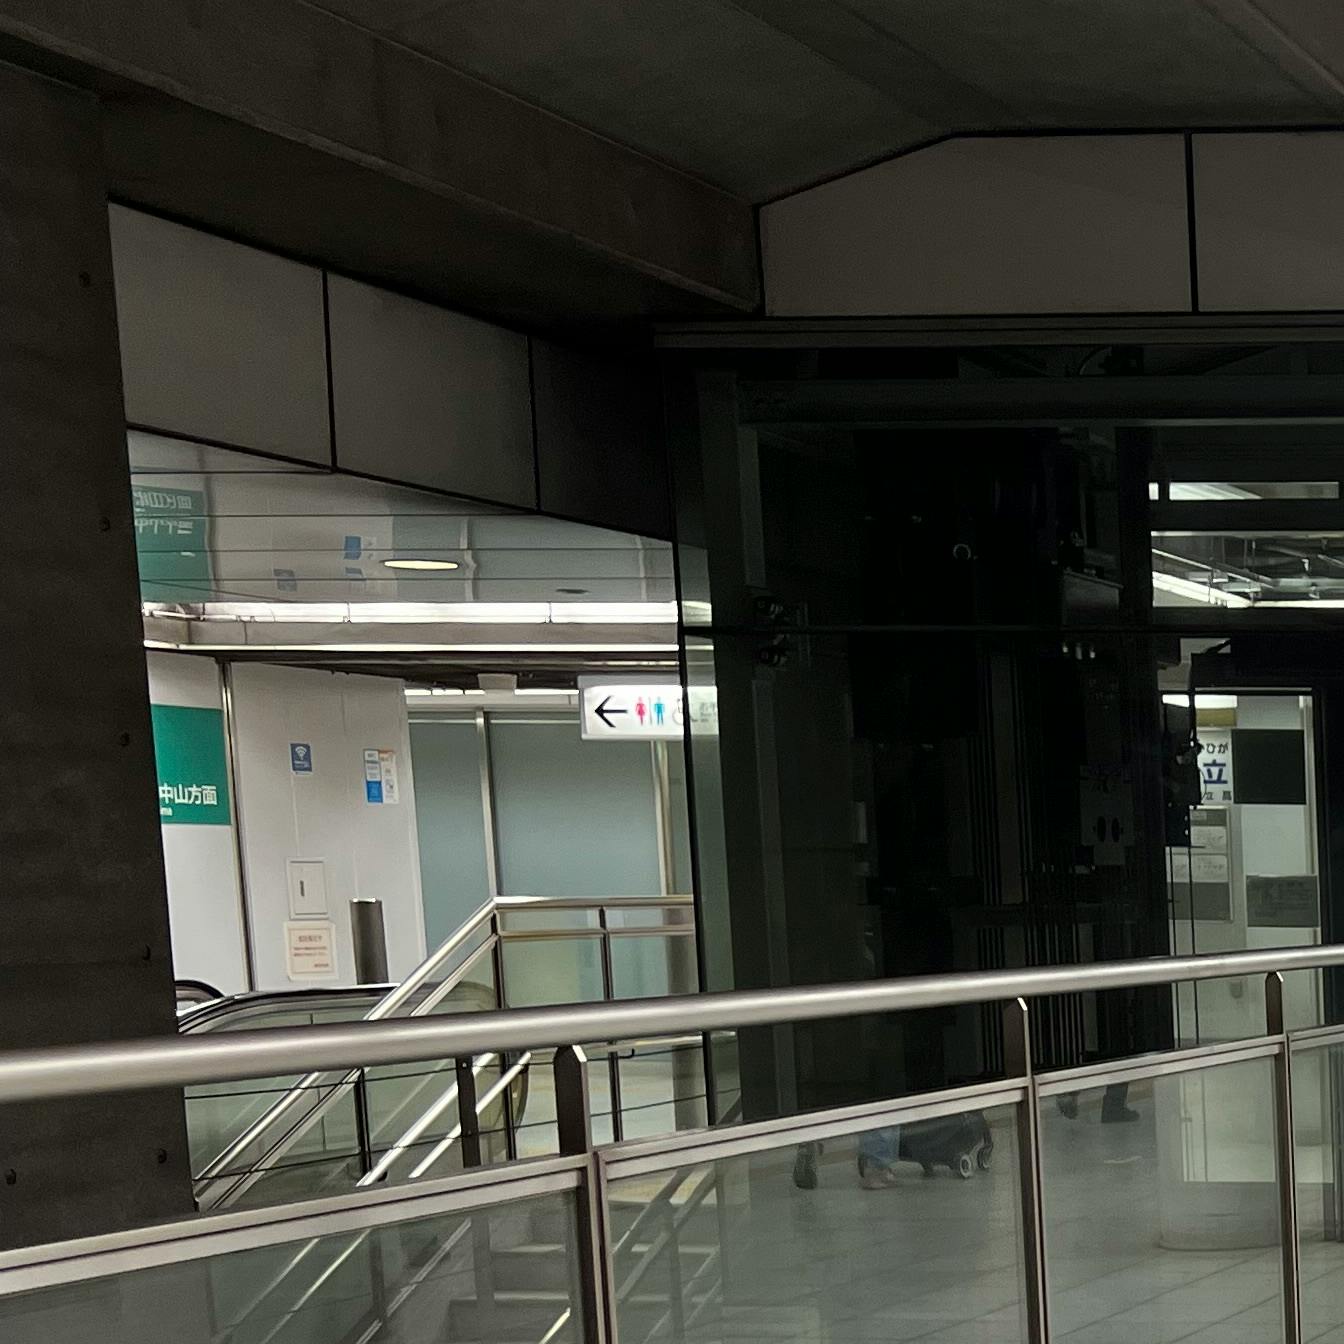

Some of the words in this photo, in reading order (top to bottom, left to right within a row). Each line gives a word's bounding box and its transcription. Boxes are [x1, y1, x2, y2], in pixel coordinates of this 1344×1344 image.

[1203, 759, 1228, 784] 立
[158, 782, 217, 805] 中山方面
